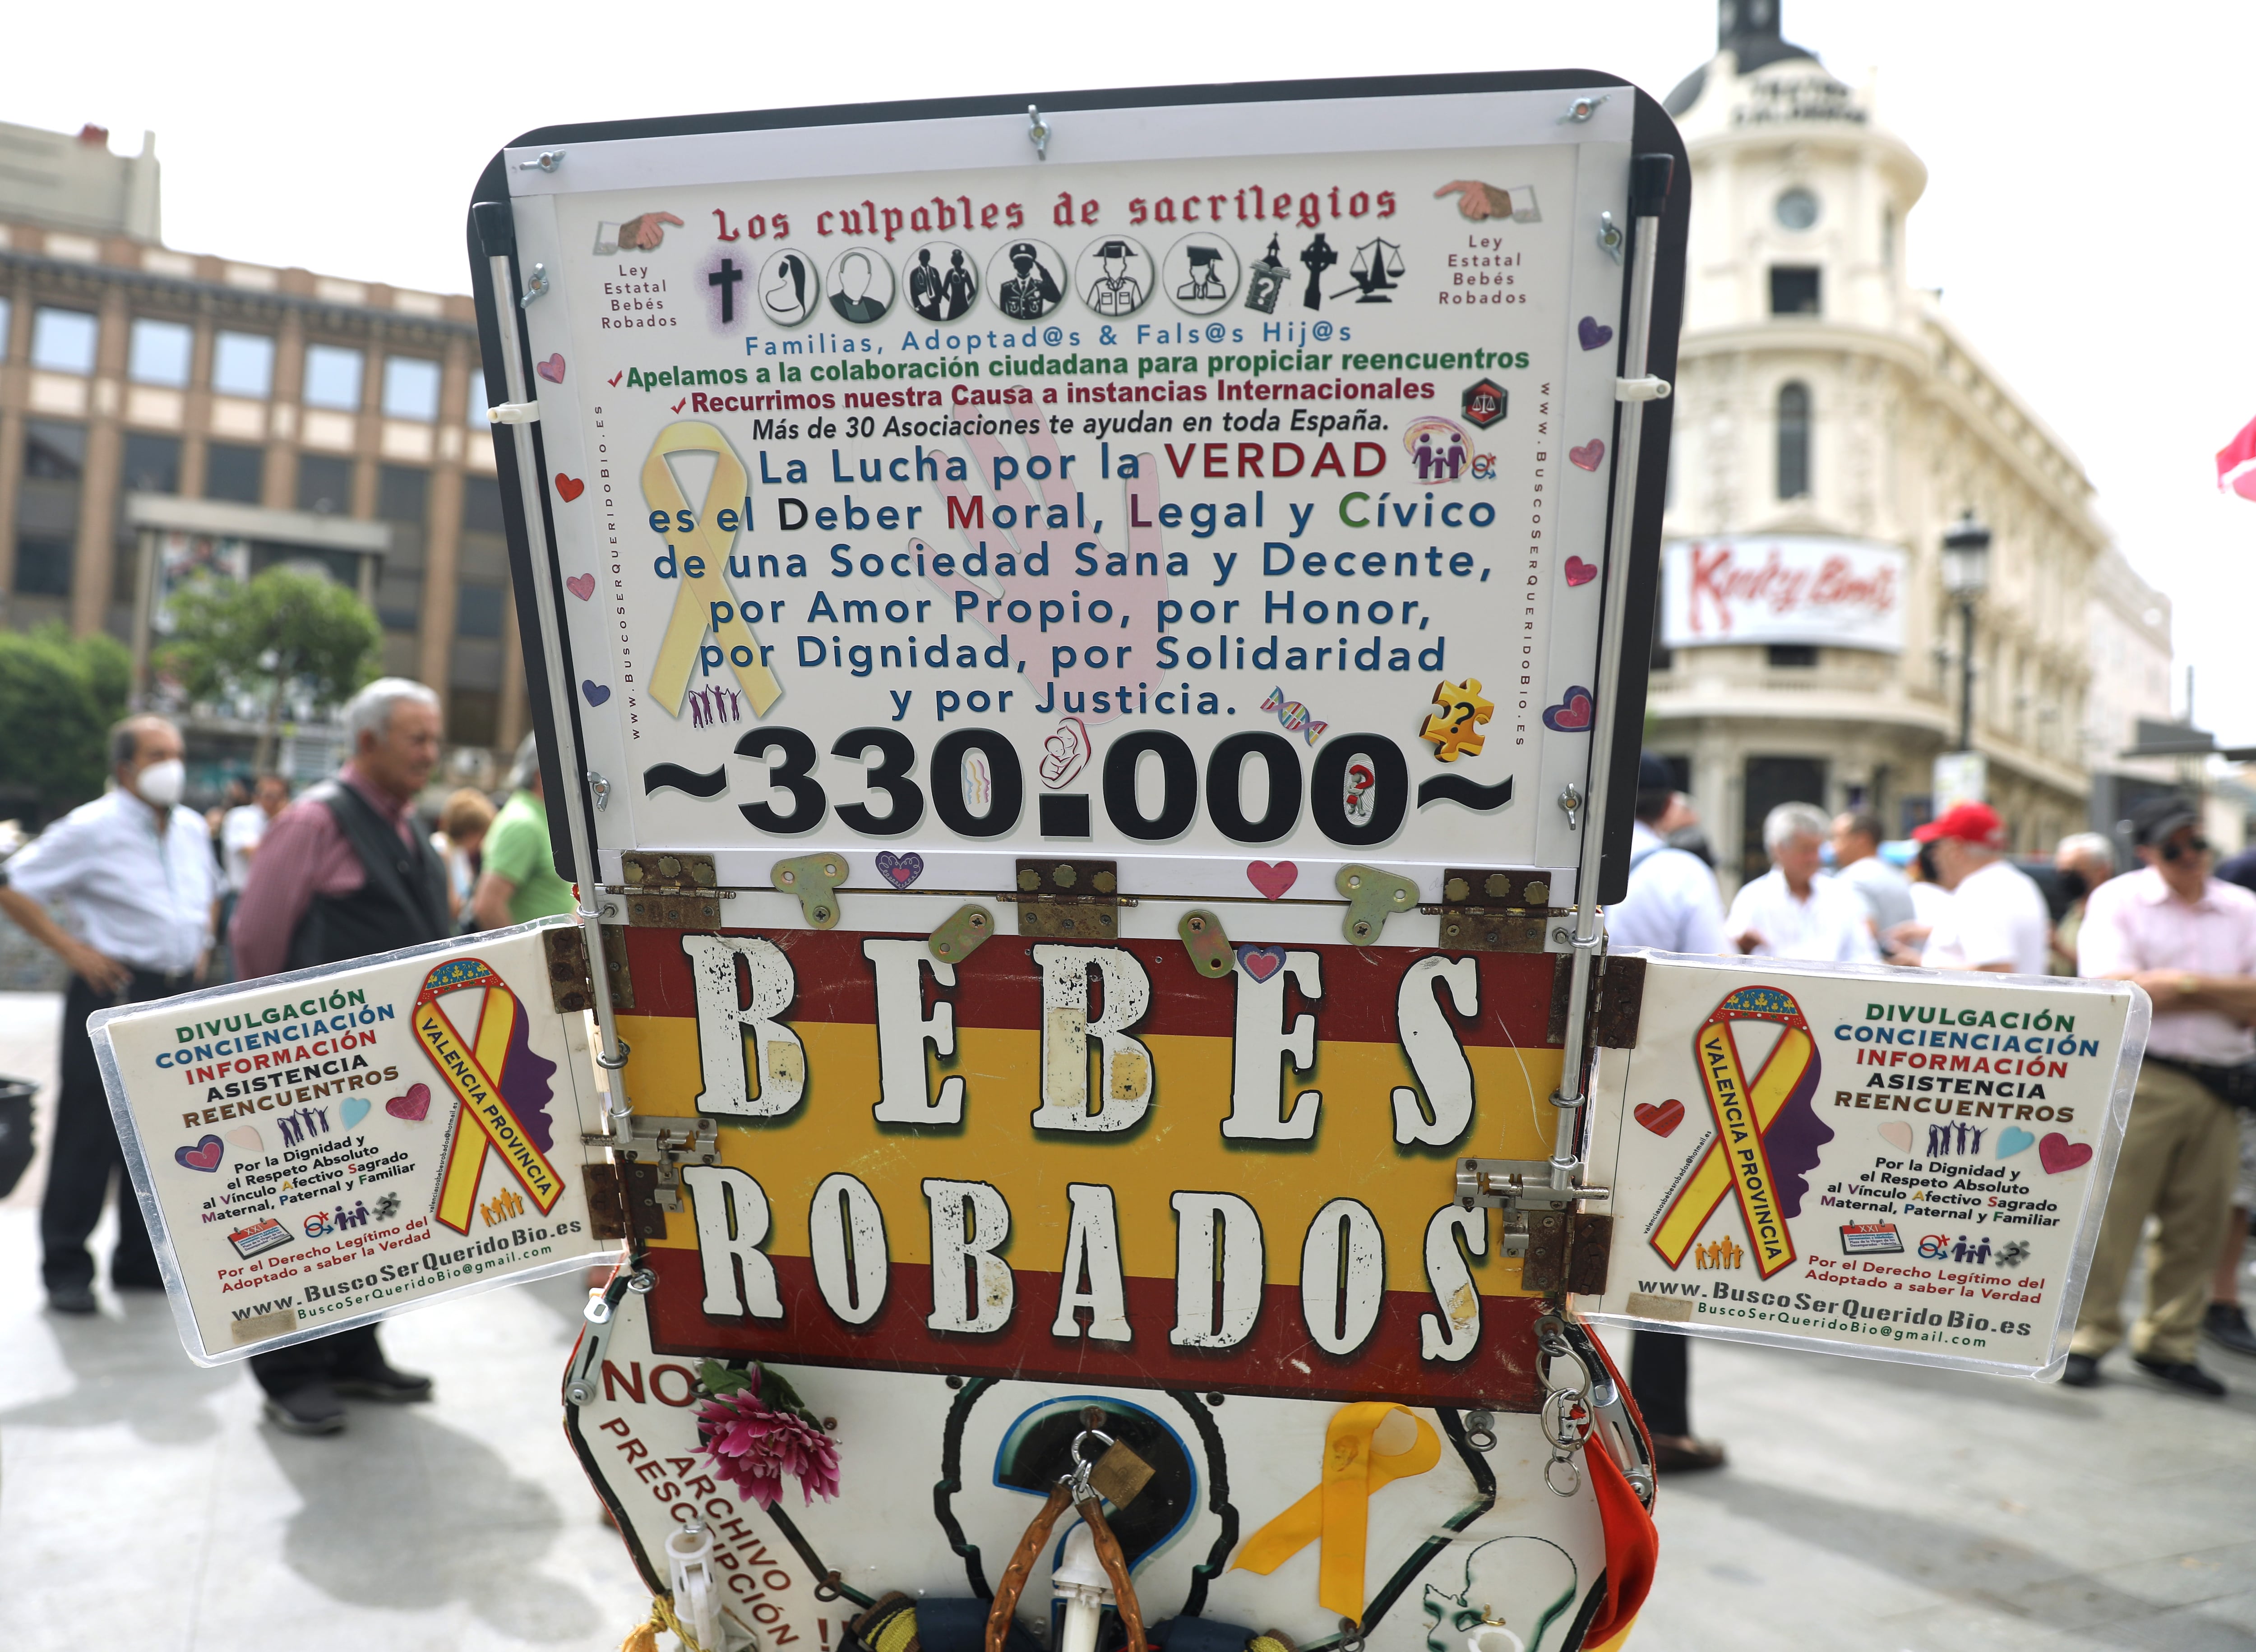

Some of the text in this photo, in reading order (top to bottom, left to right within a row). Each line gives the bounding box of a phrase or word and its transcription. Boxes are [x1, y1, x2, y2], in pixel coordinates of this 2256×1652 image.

[712, 184, 1396, 244] Los culpables de sacrilegios
[1447, 252, 1521, 268] Estatal
[1468, 234, 1502, 252] Ley
[604, 279, 666, 295] Estatal
[619, 264, 648, 280] Ley
[1453, 271, 1514, 286] Bebés
[610, 297, 664, 312] Bebés
[1438, 290, 1526, 305] Robados
[601, 314, 677, 329] Robados
[745, 320, 1351, 356] Familias, Adoptad@s & Fals@s Hij@s
[626, 347, 1530, 392] Apelamos a la colaboración ciudadana para propiciar reencuentros
[691, 376, 1435, 413] Recurrimos nuestra Causa a instancias Internacionales
[752, 407, 1389, 441] Más de 30 Asociaciones te ayudan en toda España.
[759, 441, 1387, 492] La Lucha por la VERDAD
[648, 489, 1496, 540] es el Deber Moral, Legal y Cívico
[653, 536, 1491, 587] de una Sociedad Sana y Decente,
[710, 589, 1430, 634] por Amor Propio, por Honor,
[700, 633, 1446, 678] por Dignidad, por Solidaridad
[889, 681, 1236, 722] y por Justicia.
[155, 1003, 395, 1069] CONCIENCIACIÓN
[175, 988, 366, 1043] DIVULGACIÓN
[1865, 1003, 2075, 1033] DIVULGACIÓN
[185, 1029, 377, 1085] INFORMACIÓN
[681, 935, 1479, 1146] BEBES
[1834, 1024, 2099, 1057] CONCIENCIACIÓN
[207, 1054, 369, 1103] ASISTENCIA
[1856, 1048, 2068, 1079] INFORMACIÓN
[182, 1065, 399, 1128] REENCUENTROS
[422, 1017, 552, 1195] VALENCIA PROVINCIA
[1834, 1090, 2075, 1123] REENCUENTROS
[1866, 1072, 2046, 1100] ASISTENCIA
[227, 1146, 379, 1190] el Respeto Absoluto
[234, 1135, 365, 1174] Por la Dignidad y
[1705, 1037, 1782, 1260] VALENCIA PROVINCIA
[1875, 1157, 2021, 1182] Por la Dignidad y
[201, 1163, 416, 1223] Maternal, Paternal y Familiar
[203, 1151, 408, 1209] al Vínculo Afectivo Sagrado
[1827, 1182, 2057, 1212] al Vínculo Afectivo Sagrado
[1860, 1171, 2029, 1195] el Respeto Absoluto
[244, 1224, 264, 1236] XXI
[1820, 1195, 2060, 1227] Maternal, Paternal y Familiar
[1858, 1225, 1879, 1233] XXI
[217, 1215, 428, 1280] Por el Derecho Legítimo del
[222, 1267, 298, 1293] Adoptado
[316, 1252, 357, 1269] saber
[361, 1246, 375, 1257] la
[378, 1228, 431, 1251] Verdad
[682, 1165, 1489, 1362] ROBADOS
[231, 1219, 582, 1321] www.BuscoSerQueridoBio.es
[297, 1246, 551, 1320] BuscoSerQueridoBio@gmail.com
[1804, 1269, 1887, 1288] Adoptado
[1908, 1282, 1955, 1295] saber
[1960, 1285, 1974, 1297] la
[1981, 1288, 2042, 1304] Verdad
[1808, 1255, 2045, 1289] Por el Derecho Legítimo del
[1638, 1280, 2031, 1336] www.BuscoSerQueridoBio.es
[1698, 1302, 1986, 1347] BuscoSerQueridoBio@gmail.com
[601, 1359, 698, 1407] NO
[599, 1417, 800, 1646] PRESCIPCIÓN
[665, 1456, 791, 1591] ARCHIVO
